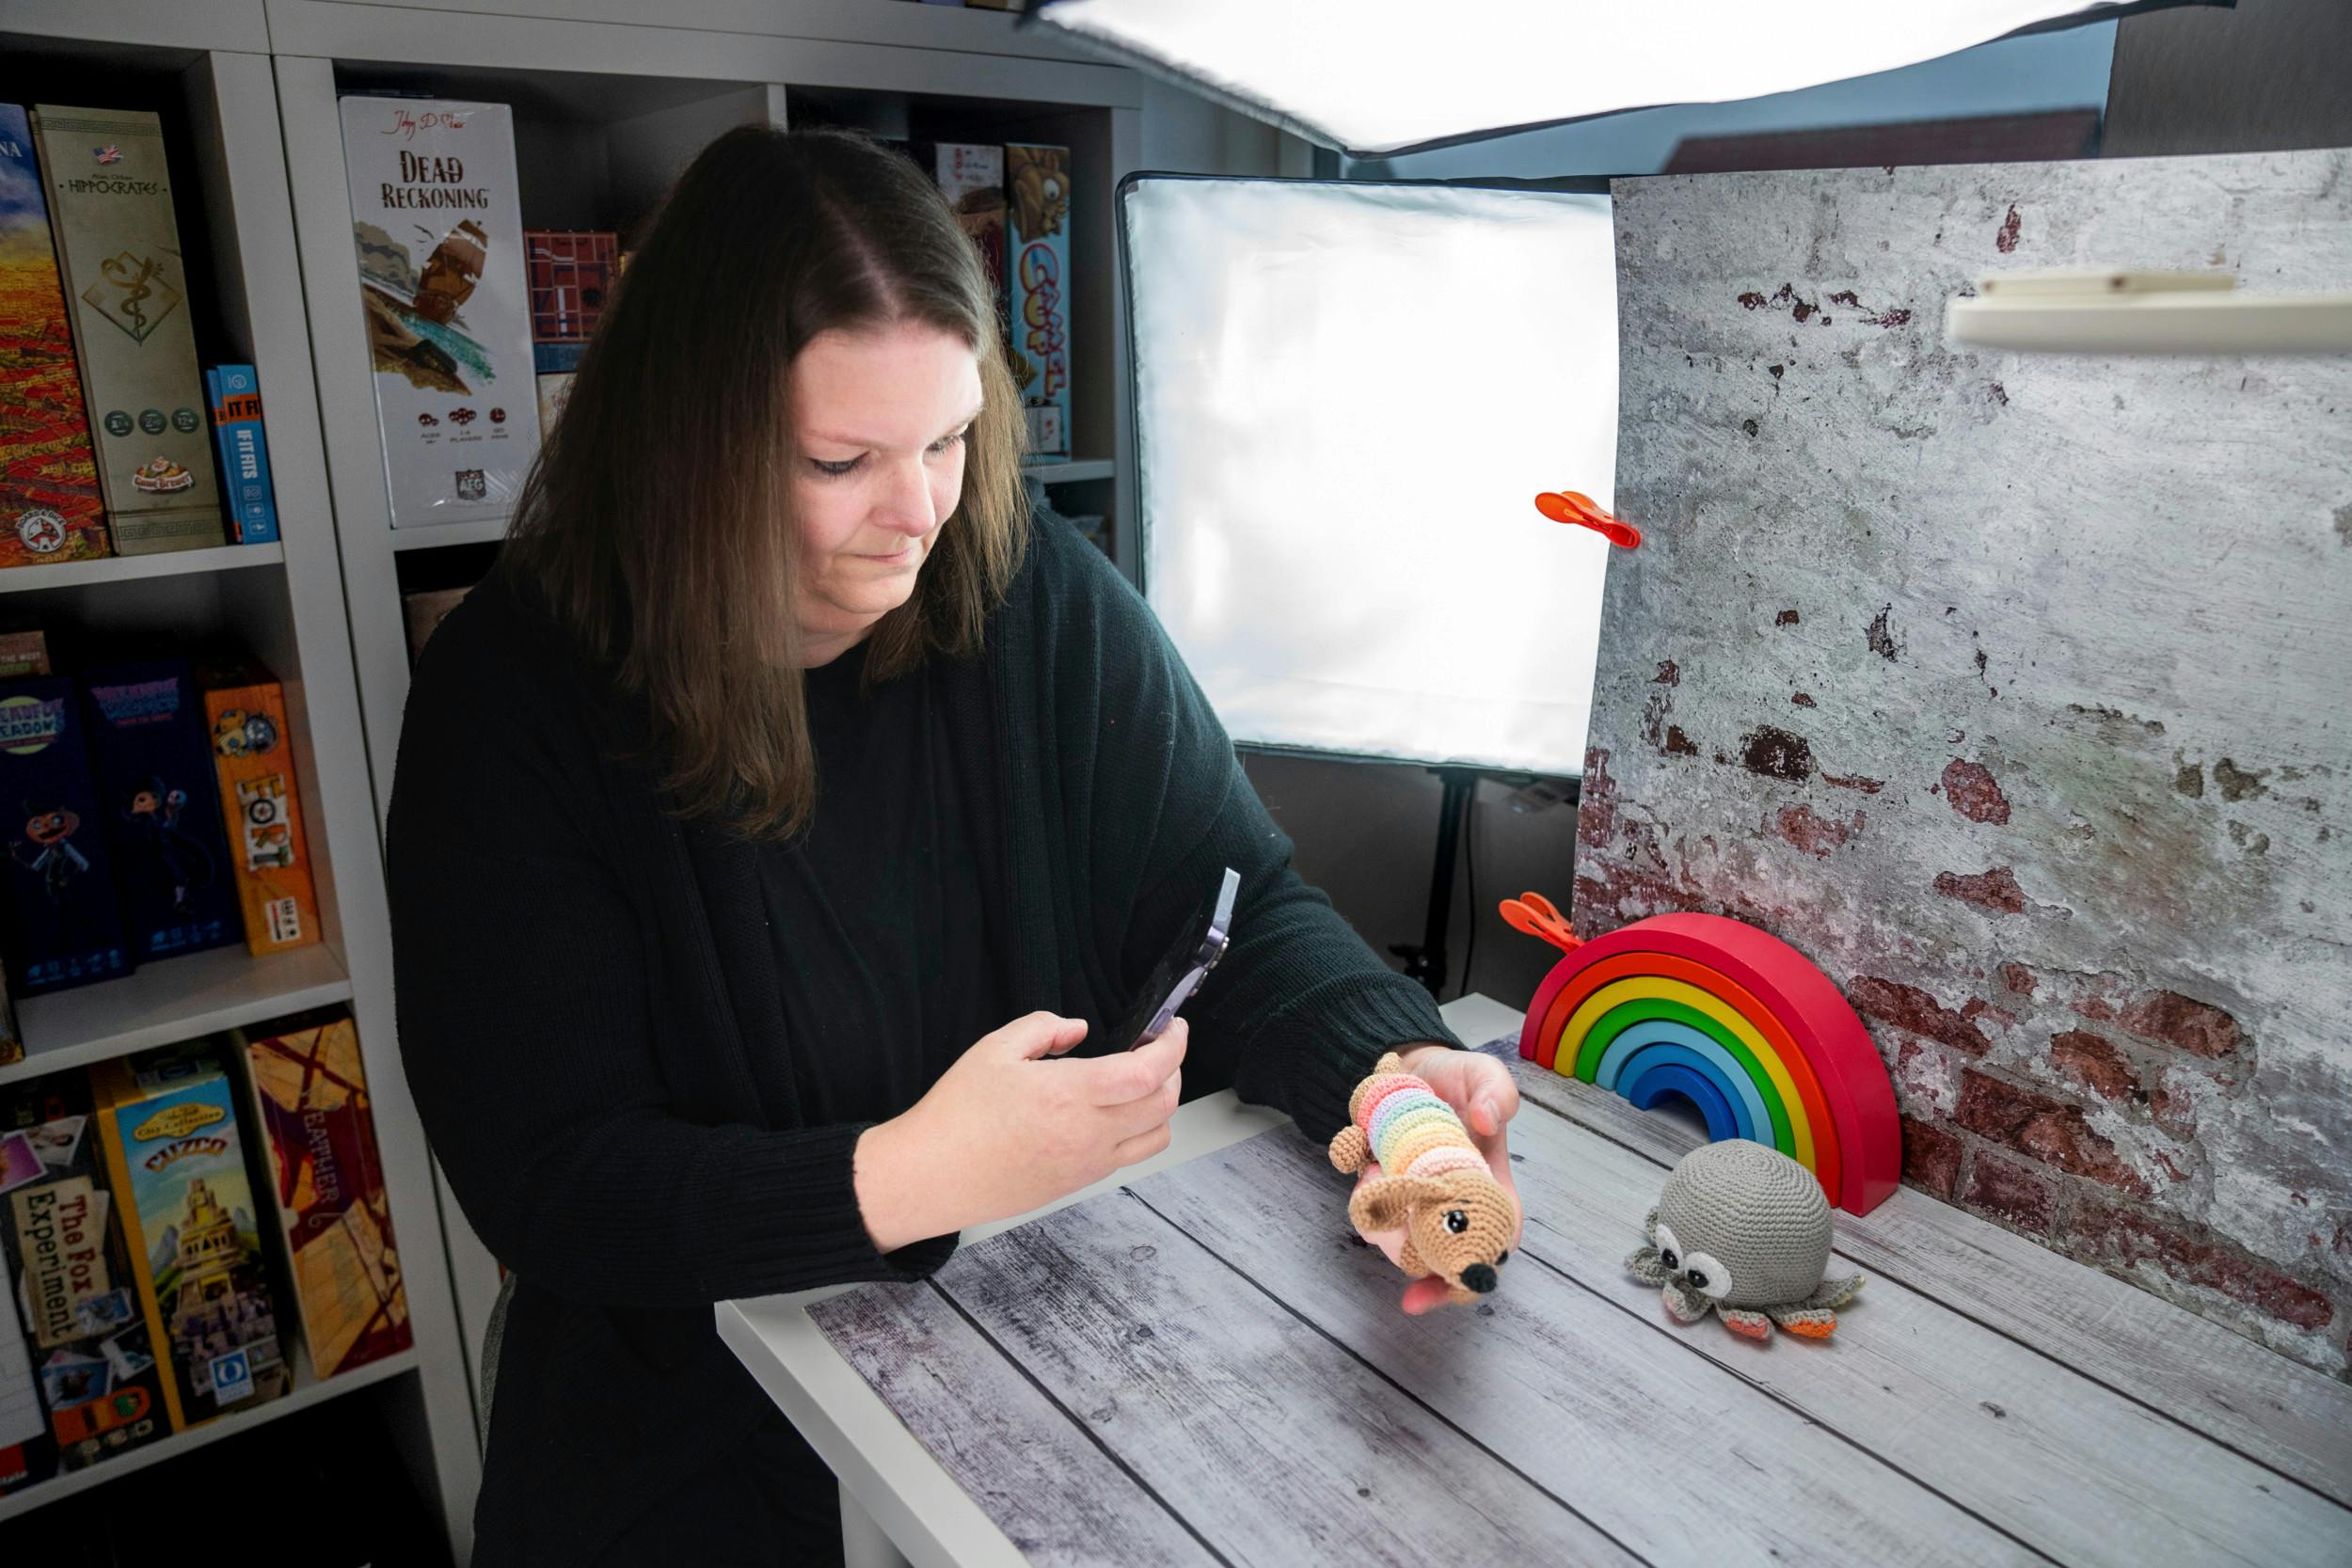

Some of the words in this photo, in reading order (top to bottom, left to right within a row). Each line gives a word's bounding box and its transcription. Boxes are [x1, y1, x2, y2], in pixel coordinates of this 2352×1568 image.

[400, 150, 463, 183] DEAD
[69, 179, 158, 196] HIPPOCRATES
[381, 182, 489, 209] RECKONING
[228, 401, 242, 418] IT
[240, 453, 258, 480] FITS
[242, 775, 288, 868] FORT
[59, 1195, 88, 1246] The
[24, 1191, 77, 1338] Experiment
[68, 1248, 95, 1294] Fox
